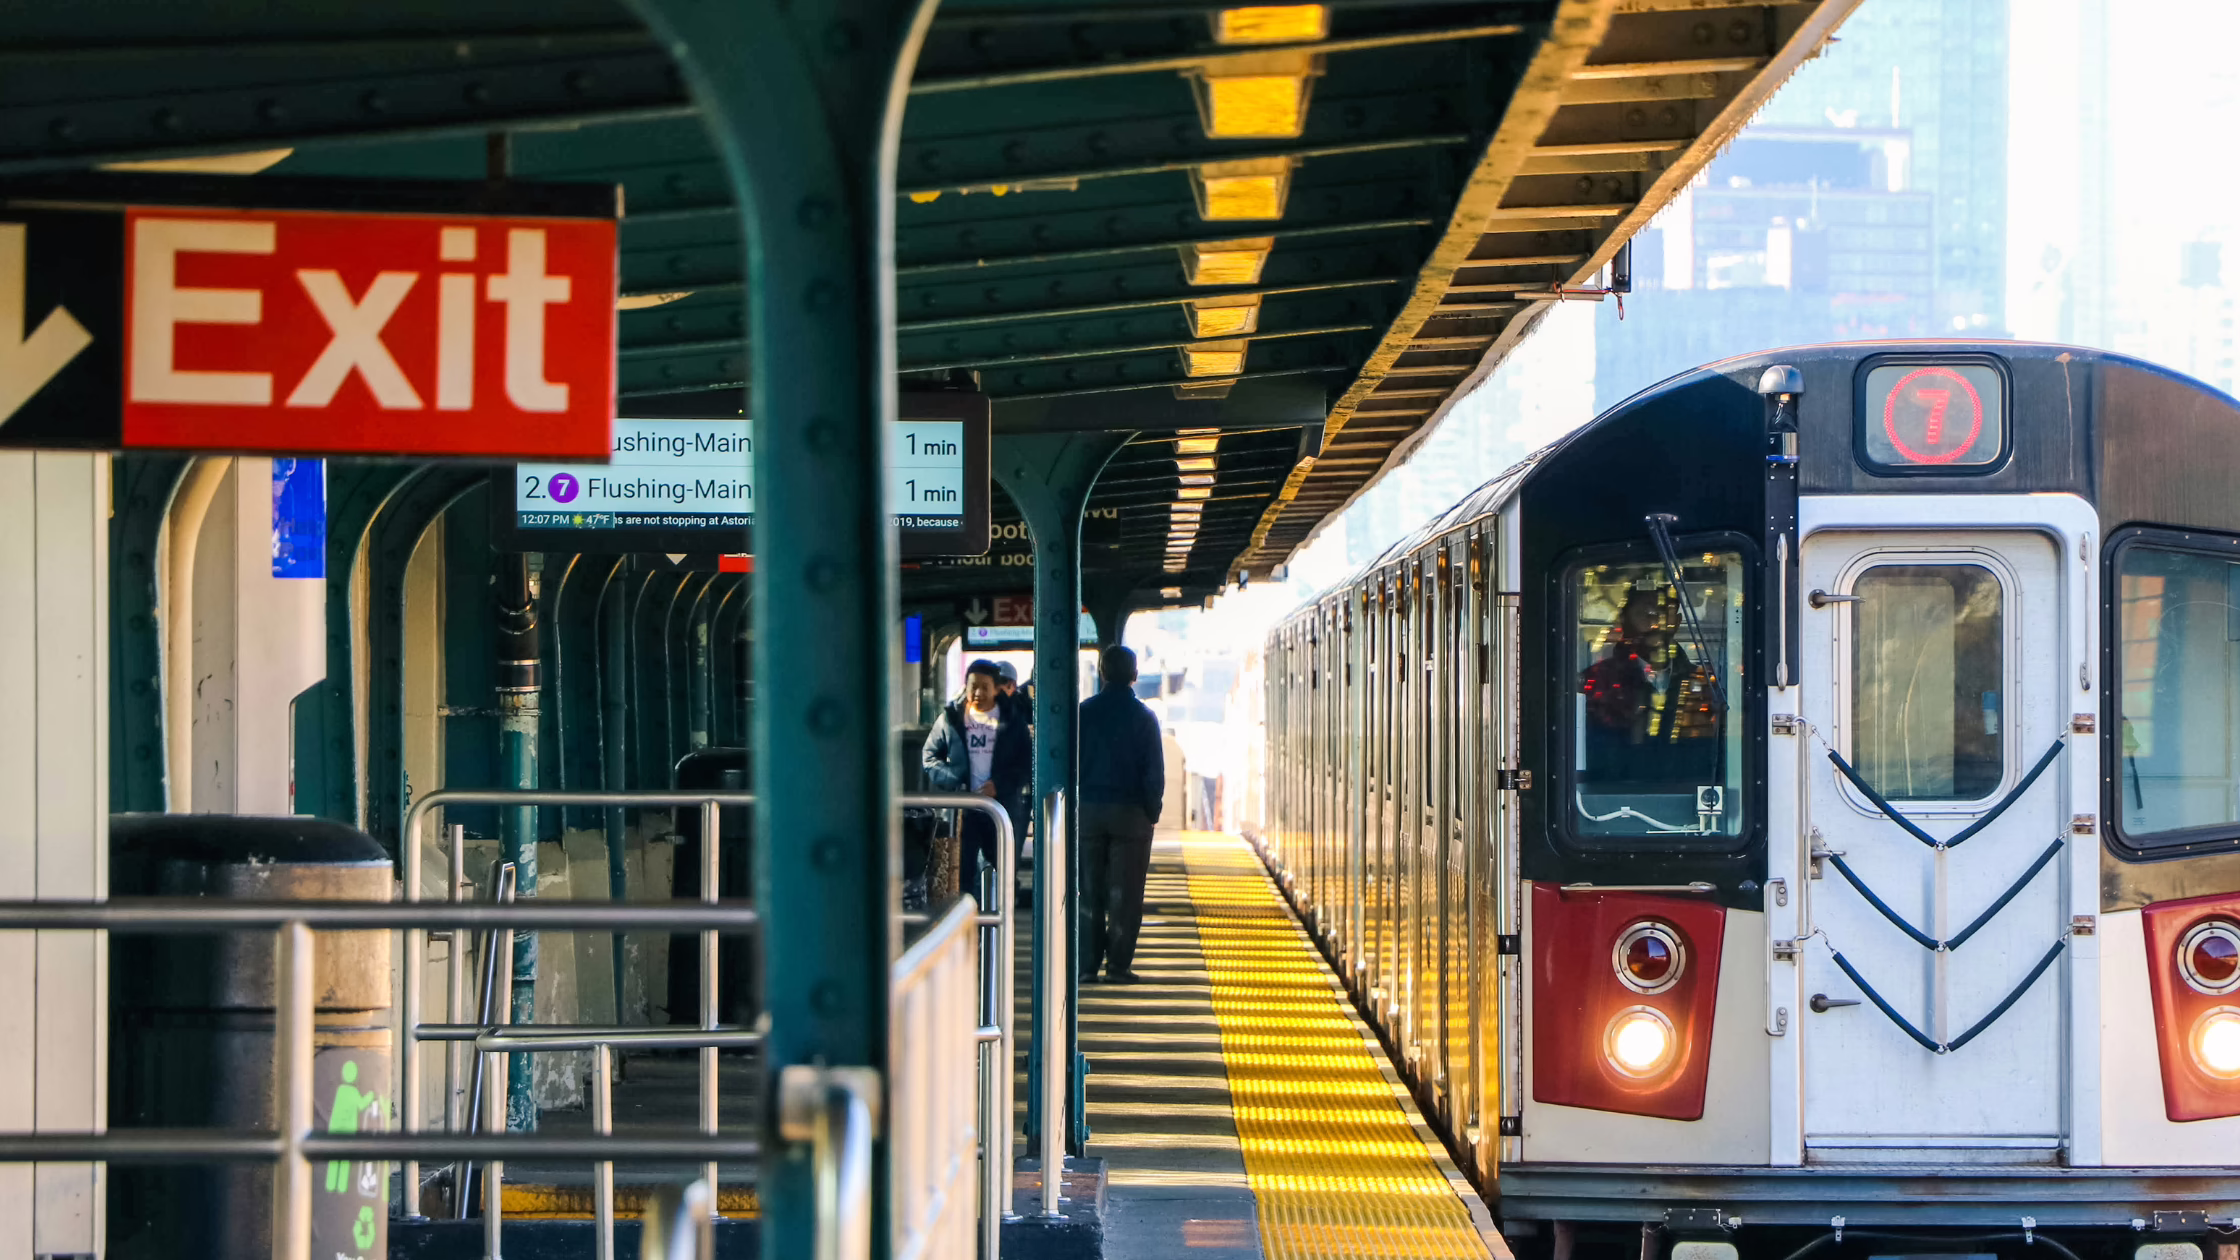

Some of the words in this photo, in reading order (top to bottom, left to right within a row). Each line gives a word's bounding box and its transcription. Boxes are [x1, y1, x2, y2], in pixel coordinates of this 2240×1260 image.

[130, 217, 571, 413] Exit
[1916, 389, 1951, 445] 7
[612, 431, 752, 457] ushing-Main
[905, 432, 916, 455] 1
[924, 440, 957, 455] min
[525, 475, 546, 499] 2.
[557, 479, 571, 497] 7
[588, 477, 752, 504] Flushing-Main
[905, 479, 916, 501] 1
[924, 486, 957, 502] min
[522, 514, 550, 525] 12:07
[552, 514, 570, 525] PM
[626, 516, 642, 526] are
[644, 514, 661, 526] not
[662, 515, 707, 528] stopping
[708, 515, 719, 526] at
[917, 516, 959, 527] because
[993, 598, 1035, 623] Exi
